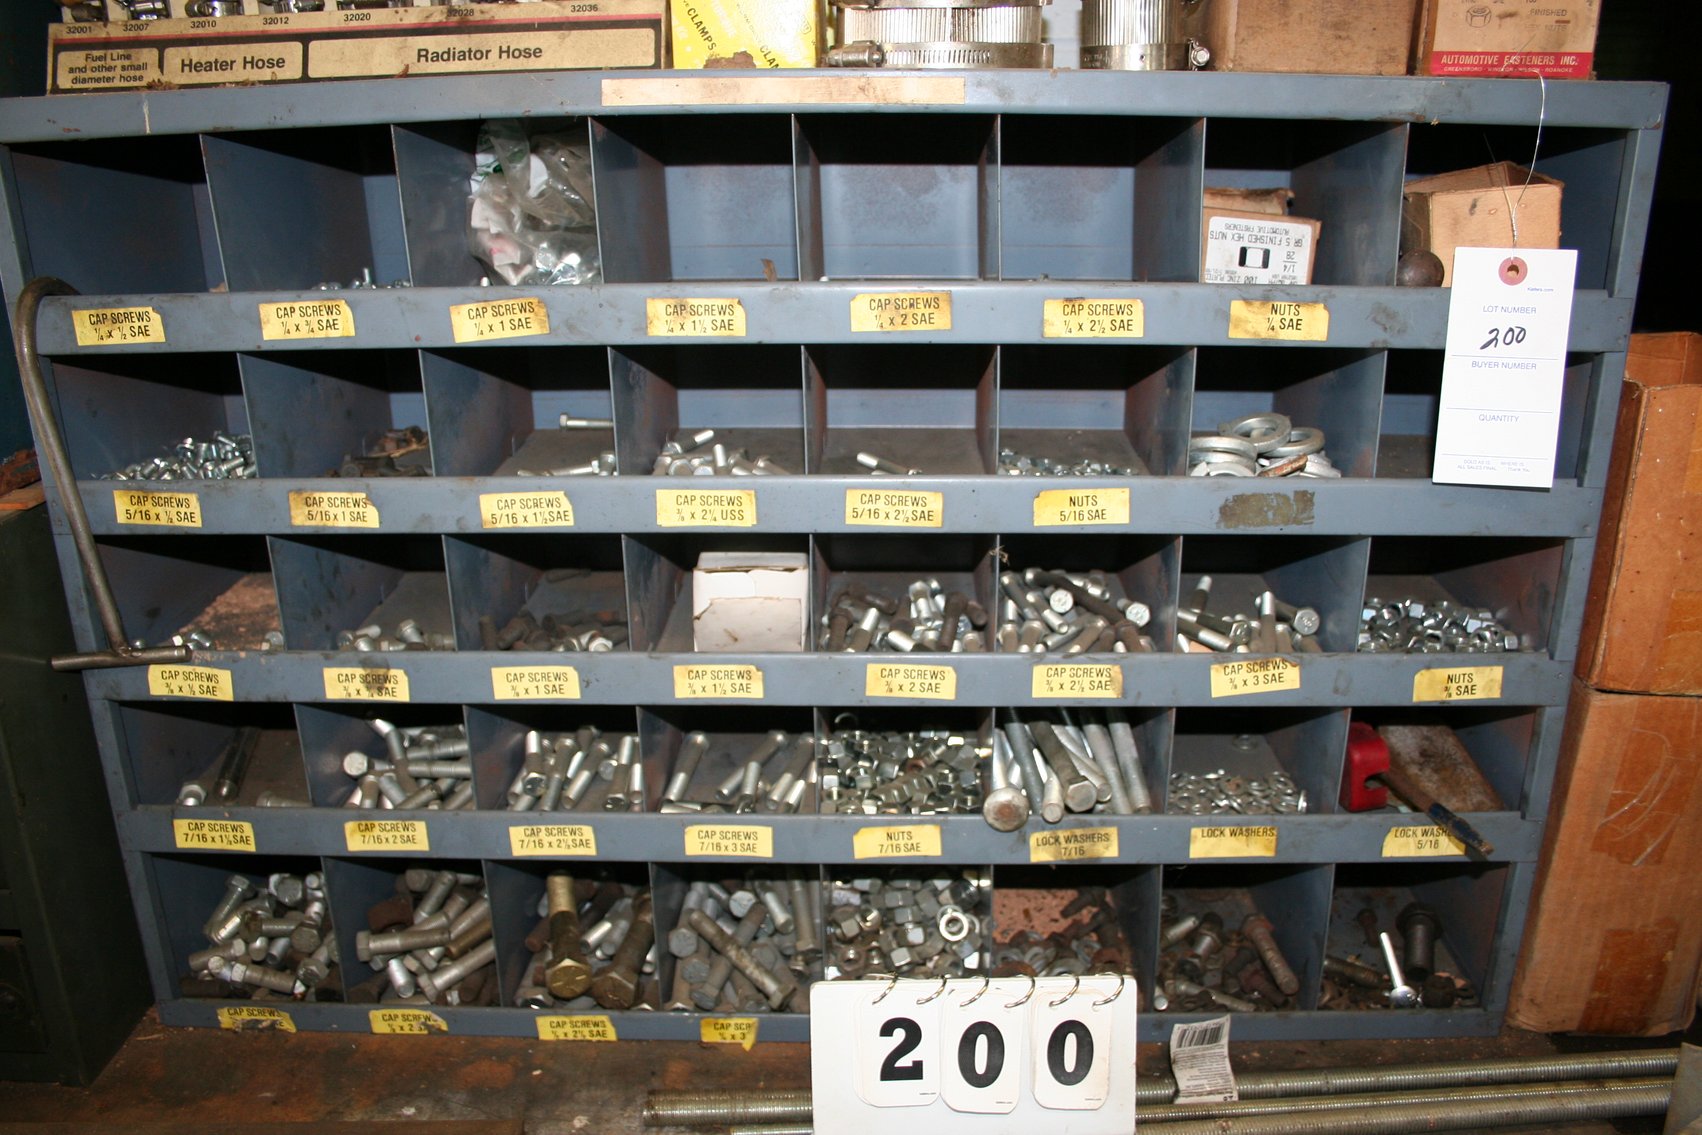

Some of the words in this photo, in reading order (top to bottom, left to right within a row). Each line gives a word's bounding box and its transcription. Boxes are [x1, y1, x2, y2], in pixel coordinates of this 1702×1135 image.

[66, 25, 92, 34] 32001
[123, 24, 149, 32] 32007
[190, 20, 217, 29] 32010
[262, 17, 290, 26] 32012
[344, 12, 371, 22] 32020
[571, 4, 598, 12] 32036
[687, 8, 717, 51] CLAMPS
[85, 53, 107, 63] Fuel
[110, 52, 132, 62] Line
[417, 46, 492, 63] Radiator
[499, 44, 543, 60] Hose
[180, 57, 236, 73] Heater
[243, 55, 286, 70] Hose
[1441, 55, 1498, 65] AUTOMOTIVE
[1504, 56, 1555, 66] FASTENERS
[1560, 56, 1578, 66] INC.
[68, 64, 86, 74] and
[90, 63, 118, 73] other
[120, 62, 148, 72] small
[71, 74, 114, 85] diameter
[117, 73, 144, 82] hose
[1210, 230, 1228, 240] NUTS
[1231, 233, 1244, 242] HEX
[1248, 234, 1282, 246] FINISHED
[665, 304, 686, 316] CAP
[689, 304, 735, 316] SCREWS
[869, 298, 891, 311] CAP
[894, 297, 940, 310] SCREWS
[1062, 304, 1084, 316] CAP
[1088, 304, 1134, 316] SCREWS
[1270, 304, 1301, 316] NUTS
[1501, 306, 1537, 314] NUMBER
[276, 307, 295, 319] CAP
[300, 304, 341, 318] SCREWS
[467, 307, 488, 320] CAP
[491, 301, 535, 317] SCREWS
[89, 313, 108, 325] CAP
[110, 310, 151, 324] SCREWS
[509, 317, 532, 330] SAE
[900, 314, 908, 326] 2
[912, 312, 935, 325] SAE
[318, 318, 340, 331] SAE
[711, 320, 734, 331] SAE
[1110, 320, 1134, 332] SAE
[1278, 318, 1303, 330] SAE
[130, 324, 150, 338] SAE
[1480, 326, 1527, 350] 200
[1472, 361, 1500, 369] BUYER
[1502, 362, 1537, 370] NUMBER
[1479, 414, 1520, 423] QUANTITY
[130, 495, 149, 506] CAP
[151, 496, 190, 508] SCREWS
[305, 496, 324, 508] CAP
[327, 496, 368, 508] SCREWS
[496, 498, 516, 510] CAP
[519, 497, 562, 510] SCREWS
[676, 494, 697, 506] CAP
[699, 495, 743, 507] SCREWS
[860, 493, 881, 506] CAP
[884, 495, 928, 508] SCREWS
[1069, 495, 1098, 507] NUTS
[125, 509, 151, 522] 5/16
[176, 511, 196, 524] SAE
[307, 510, 332, 522] 5/16
[349, 511, 368, 522] SAE
[490, 512, 518, 525] 5/16
[720, 510, 744, 521] USS
[852, 508, 880, 520] 5/16
[910, 510, 934, 522] SAE
[1060, 510, 1085, 522] 5/16
[1087, 508, 1107, 520] SAE
[1046, 668, 1066, 678] CAP
[1069, 667, 1112, 678] SCREWS
[1223, 663, 1244, 676] CAP
[1246, 659, 1288, 674] SCREWS
[161, 670, 180, 682] CAP
[182, 671, 220, 684] SCREWS
[337, 673, 357, 684] CAP
[359, 674, 399, 685] SCREWS
[506, 672, 525, 683] CAP
[528, 672, 568, 683] SCREWS
[688, 670, 708, 680] CAP
[710, 670, 752, 681] SCREWS
[880, 668, 901, 679] CAP
[903, 668, 946, 681] SCREWS
[1253, 674, 1260, 686] 3
[1262, 672, 1285, 685] SAE
[1446, 672, 1474, 684] NUTS
[198, 684, 218, 696] SAE
[544, 684, 565, 695] SAE
[730, 682, 752, 694] SAE
[909, 682, 916, 693] 2
[920, 682, 941, 694] SAE
[1088, 680, 1111, 691] SAE
[1456, 684, 1477, 696] SAE
[377, 686, 397, 698] SAE
[188, 822, 206, 832] CAP
[208, 822, 244, 834] SCREWS
[358, 822, 376, 833] CAP
[378, 822, 416, 833] SCREWS
[524, 827, 542, 838] CAP
[544, 826, 584, 838] SCREWS
[1201, 827, 1226, 838] LOCK
[1228, 826, 1276, 838] WASHERS
[1394, 828, 1418, 838] LOCK
[182, 832, 208, 844] 7/16
[232, 835, 251, 846] SAE
[360, 834, 382, 844] 7/16
[392, 834, 398, 844] 2
[400, 834, 417, 844] SAE
[698, 829, 717, 840] CAP
[719, 830, 758, 842] SCREWS
[886, 831, 912, 842] NUTS
[1036, 835, 1062, 848] LOCK
[1064, 832, 1110, 846] WASHERS
[519, 838, 544, 850] 7/16
[572, 838, 592, 850] SAE
[699, 842, 722, 852] 7/16
[732, 842, 738, 853] 3
[740, 842, 758, 854] SAE
[878, 843, 902, 854] 7/16
[903, 842, 921, 853] SAE
[1416, 839, 1440, 850] 5/16
[1061, 845, 1086, 857] 7/16
[227, 1008, 244, 1016] CAP
[382, 1014, 398, 1022] CAP
[550, 1020, 567, 1029] CAP
[569, 1020, 606, 1029] SCREWS
[714, 1022, 730, 1031] CAP
[588, 1030, 608, 1039] SAE
